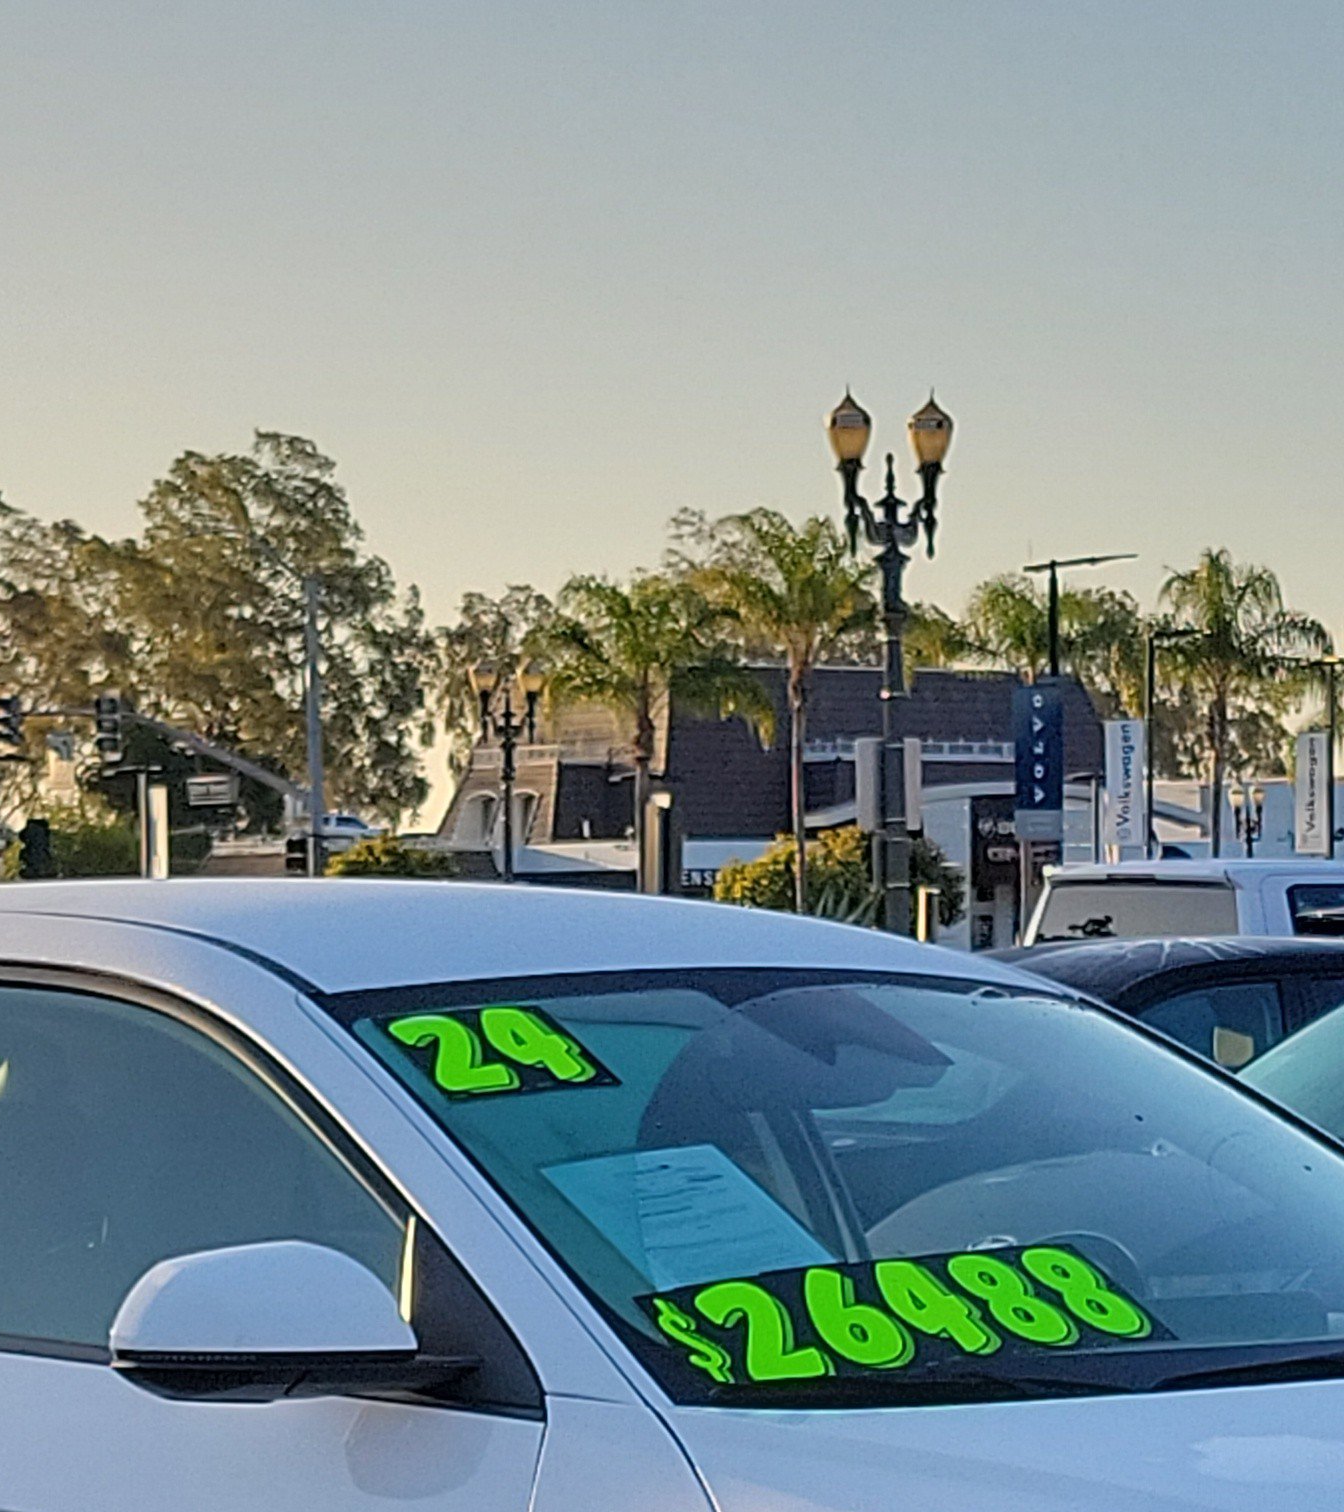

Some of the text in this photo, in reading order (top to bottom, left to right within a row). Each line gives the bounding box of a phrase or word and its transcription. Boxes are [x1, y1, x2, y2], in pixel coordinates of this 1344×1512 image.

[1031, 693, 1046, 803] VOLVO
[1116, 723, 1136, 827] Volkswagen
[388, 1006, 598, 1094] 24
[655, 1247, 1152, 1384] $26488
